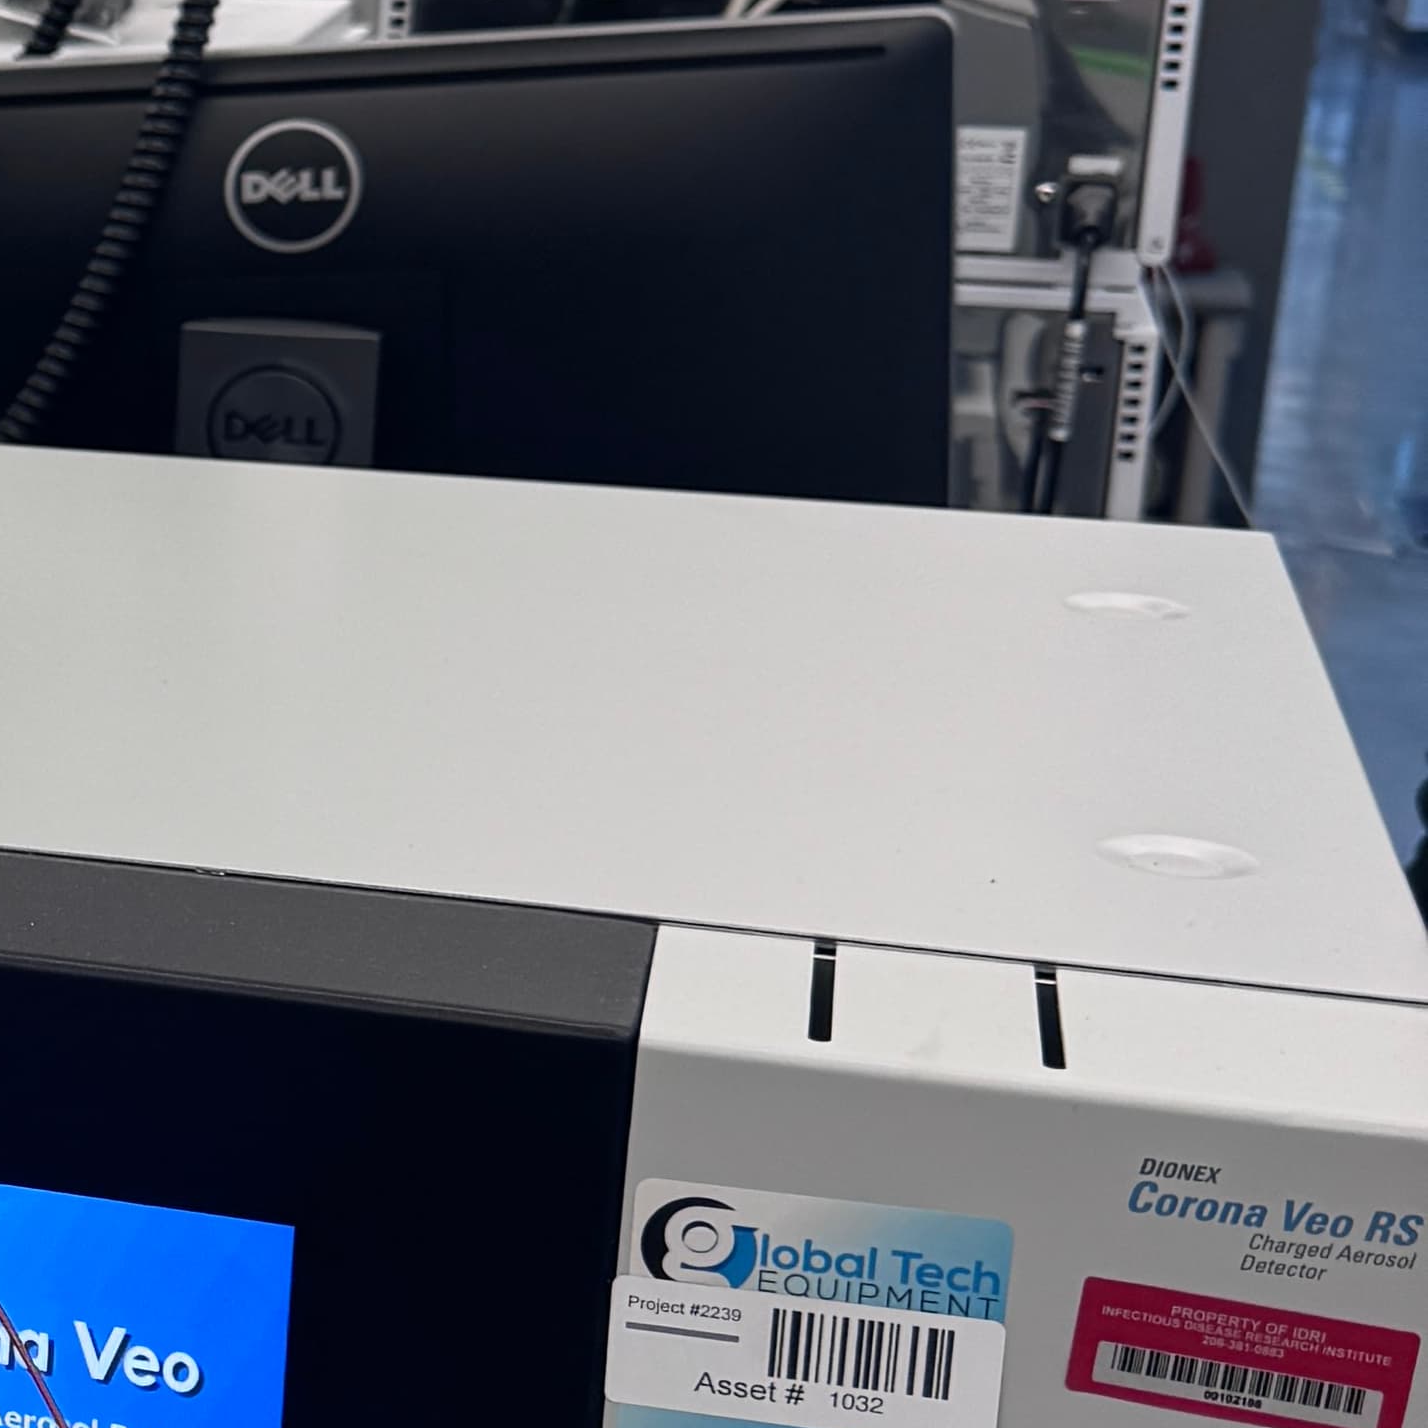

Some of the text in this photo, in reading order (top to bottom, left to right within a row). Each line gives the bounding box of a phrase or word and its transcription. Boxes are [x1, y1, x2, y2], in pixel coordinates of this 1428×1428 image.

[241, 167, 345, 205] DELL
[223, 410, 327, 448] DELL
[1139, 1157, 1223, 1185] DIONEX
[1128, 1180, 1425, 1248] Corona Veo RS
[1240, 1254, 1328, 1281] Detector
[1248, 1232, 1418, 1271] Charged Aerosol
[891, 1249, 1001, 1296] Tech
[627, 1293, 743, 1323] Project #2239
[757, 1269, 1001, 1320] EQUIPMENT
[1101, 1305, 1393, 1368] INFECTIOUS DISEASE RESEARCH INSTITUTE
[1171, 1305, 1328, 1344] PROPERTY OF IDRI
[73, 1320, 202, 1395] Veo
[693, 1371, 886, 1416] Asset # 1032
